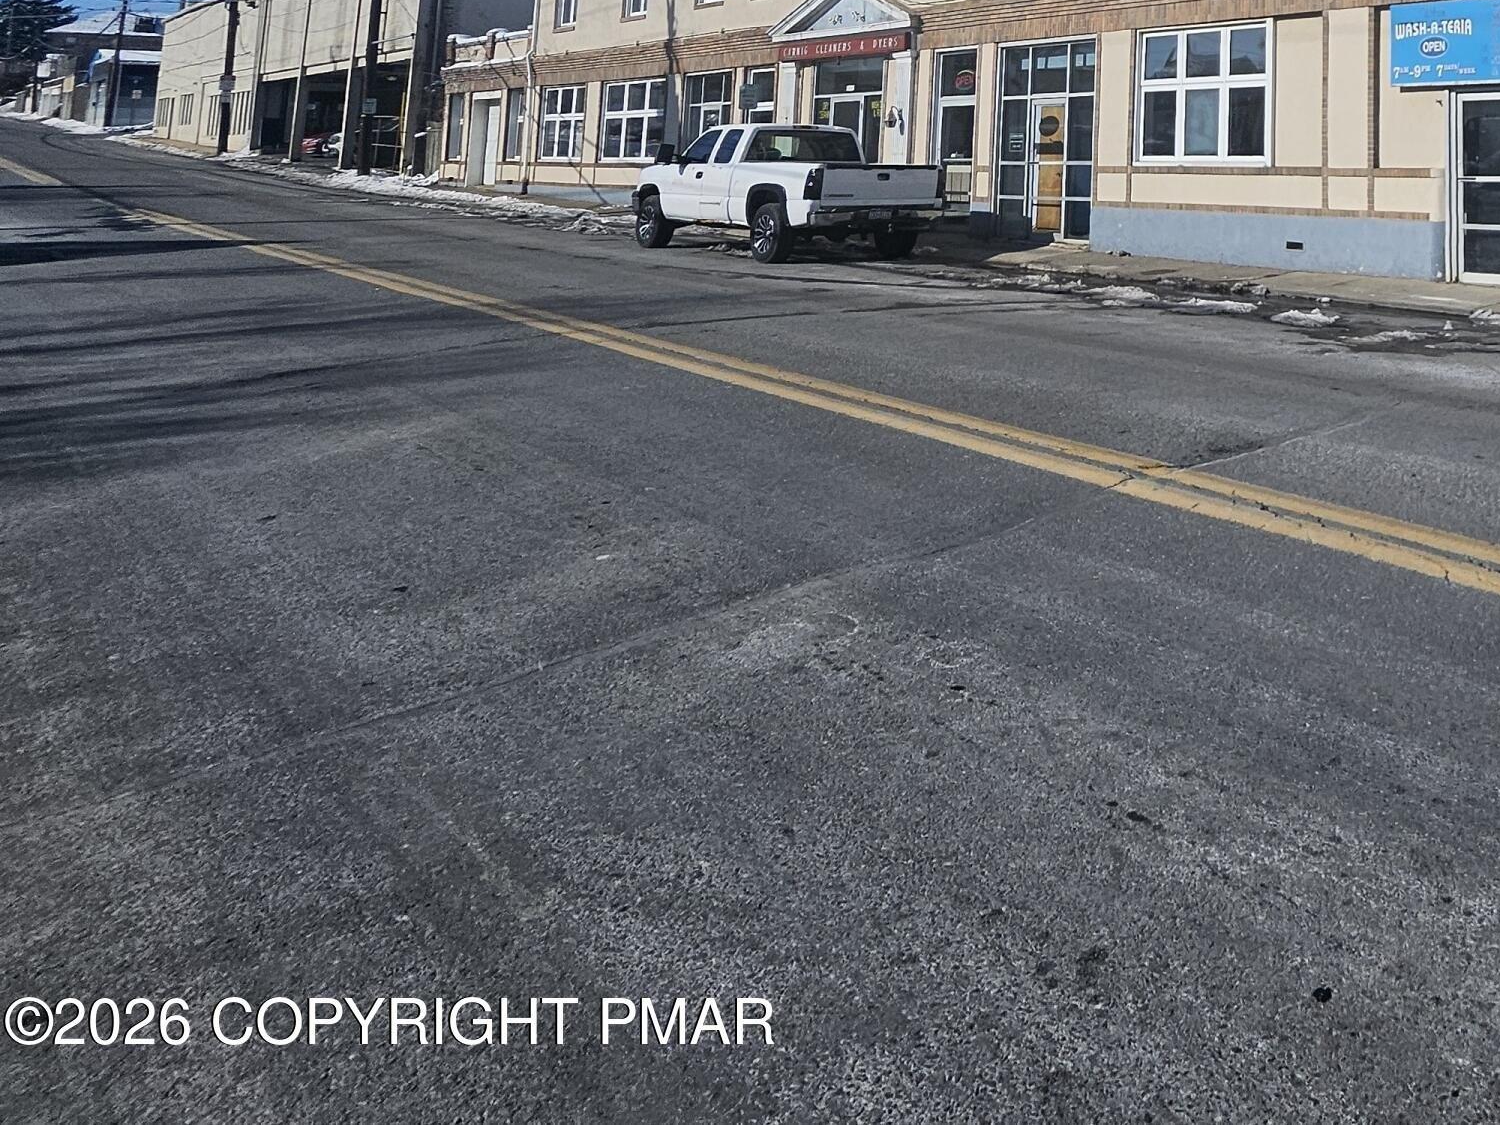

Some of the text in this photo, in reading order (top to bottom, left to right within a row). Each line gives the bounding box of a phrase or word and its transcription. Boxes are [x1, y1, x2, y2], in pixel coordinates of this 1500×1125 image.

[1395, 18, 1473, 41] WASH-A-TERIA
[815, 41, 851, 54] CLEANERS
[872, 36, 898, 49] DYERS
[1422, 41, 1446, 53] OPEN
